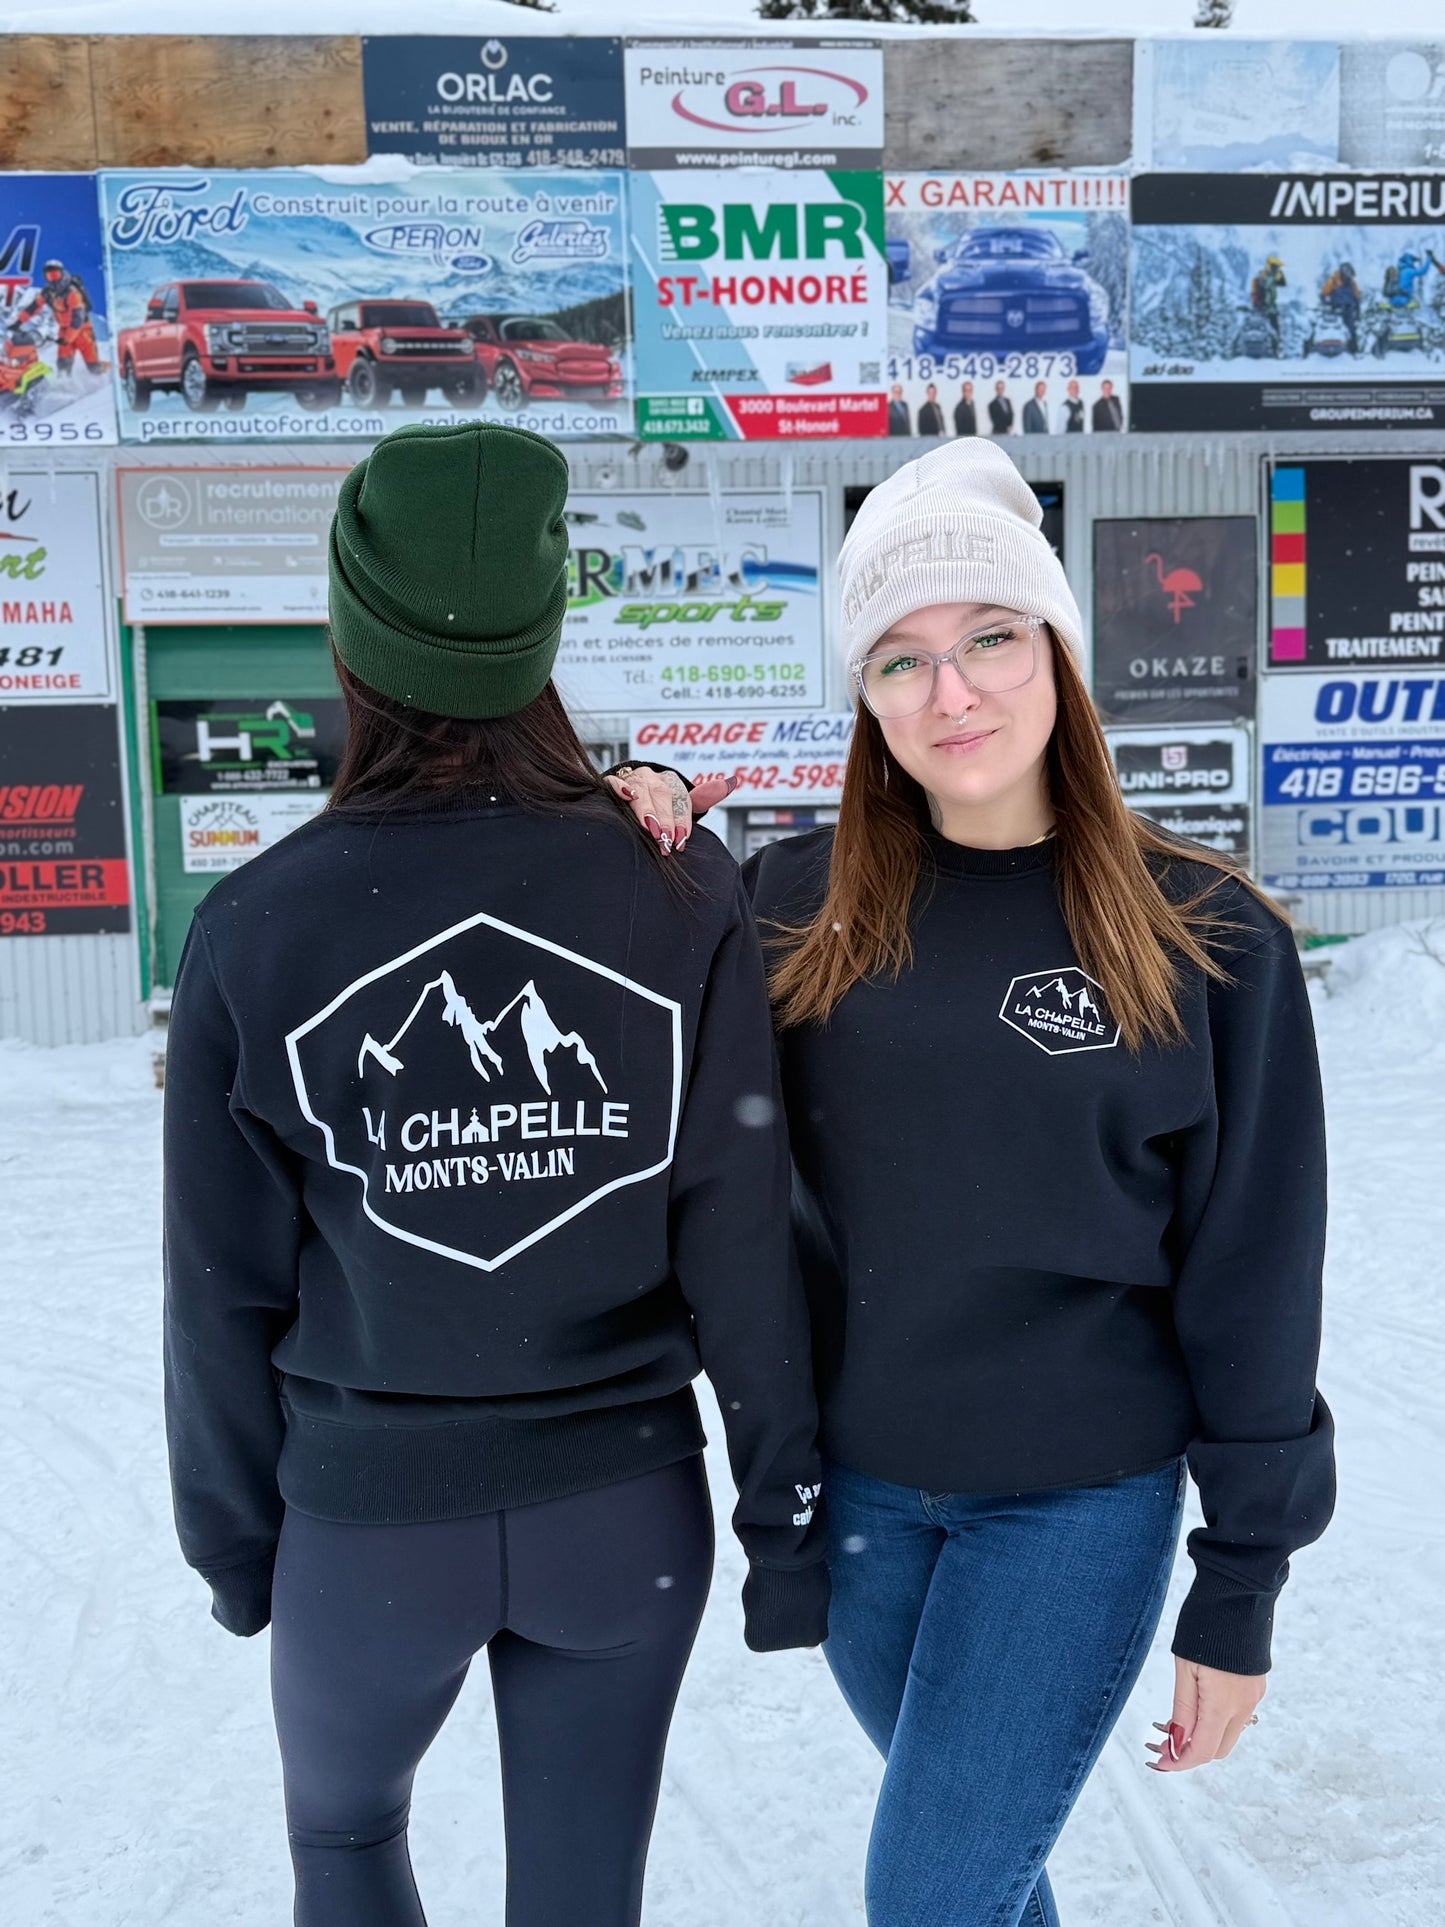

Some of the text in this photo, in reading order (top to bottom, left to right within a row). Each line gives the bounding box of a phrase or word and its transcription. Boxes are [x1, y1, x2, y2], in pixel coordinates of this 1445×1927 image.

[641, 67, 725, 85] Peinture
[437, 73, 553, 102] ORLAC
[724, 81, 828, 117] G.L.
[428, 105, 440, 115] LA
[498, 105, 510, 115] DE
[512, 105, 566, 115] CONFIANCE
[832, 112, 862, 126] inc.
[371, 119, 617, 134] VENTE, RÉPARATION ET FABRICATION
[438, 134, 554, 145] DE BIJOUX EN OR
[527, 148, 625, 165] 418-548-2479
[676, 152, 837, 167] www.peinturegl.com
[886, 180, 906, 206] X
[112, 181, 246, 245] Ford
[253, 193, 614, 217] Construit pour la route à venir
[659, 202, 867, 261] BMR
[657, 265, 868, 307] ST-HONORÉ
[662, 321, 869, 341] Venez nous rencontrer !
[692, 369, 758, 381] KIMPEX
[887, 354, 1076, 381] 418-549-2873
[739, 398, 879, 414] 3000 Boulevard Martel
[141, 413, 384, 438] perronautoford.com
[778, 418, 839, 434] St-Honoré
[2, 601, 73, 624] MAHA
[614, 594, 788, 630] sports
[583, 637, 602, 649] et
[608, 634, 664, 651] pièces
[670, 634, 692, 648] de
[698, 635, 795, 650] remorques
[1325, 637, 1443, 658] TRAITEMENT
[661, 664, 806, 683] 418-690-5102
[1129, 657, 1226, 678] OKAZE
[705, 685, 807, 698] 418-690-6255
[636, 722, 768, 746] GARAGE
[1352, 746, 1400, 760] Manuel
[1279, 766, 1344, 797] 418
[1297, 854, 1359, 866] SAVOIR
[1366, 854, 1385, 864] ET
[1014, 1003, 1032, 1016] LA
[1027, 1018, 1087, 1041] MONTS-VALIN
[385, 1147, 575, 1193] MONTS-VALIN
